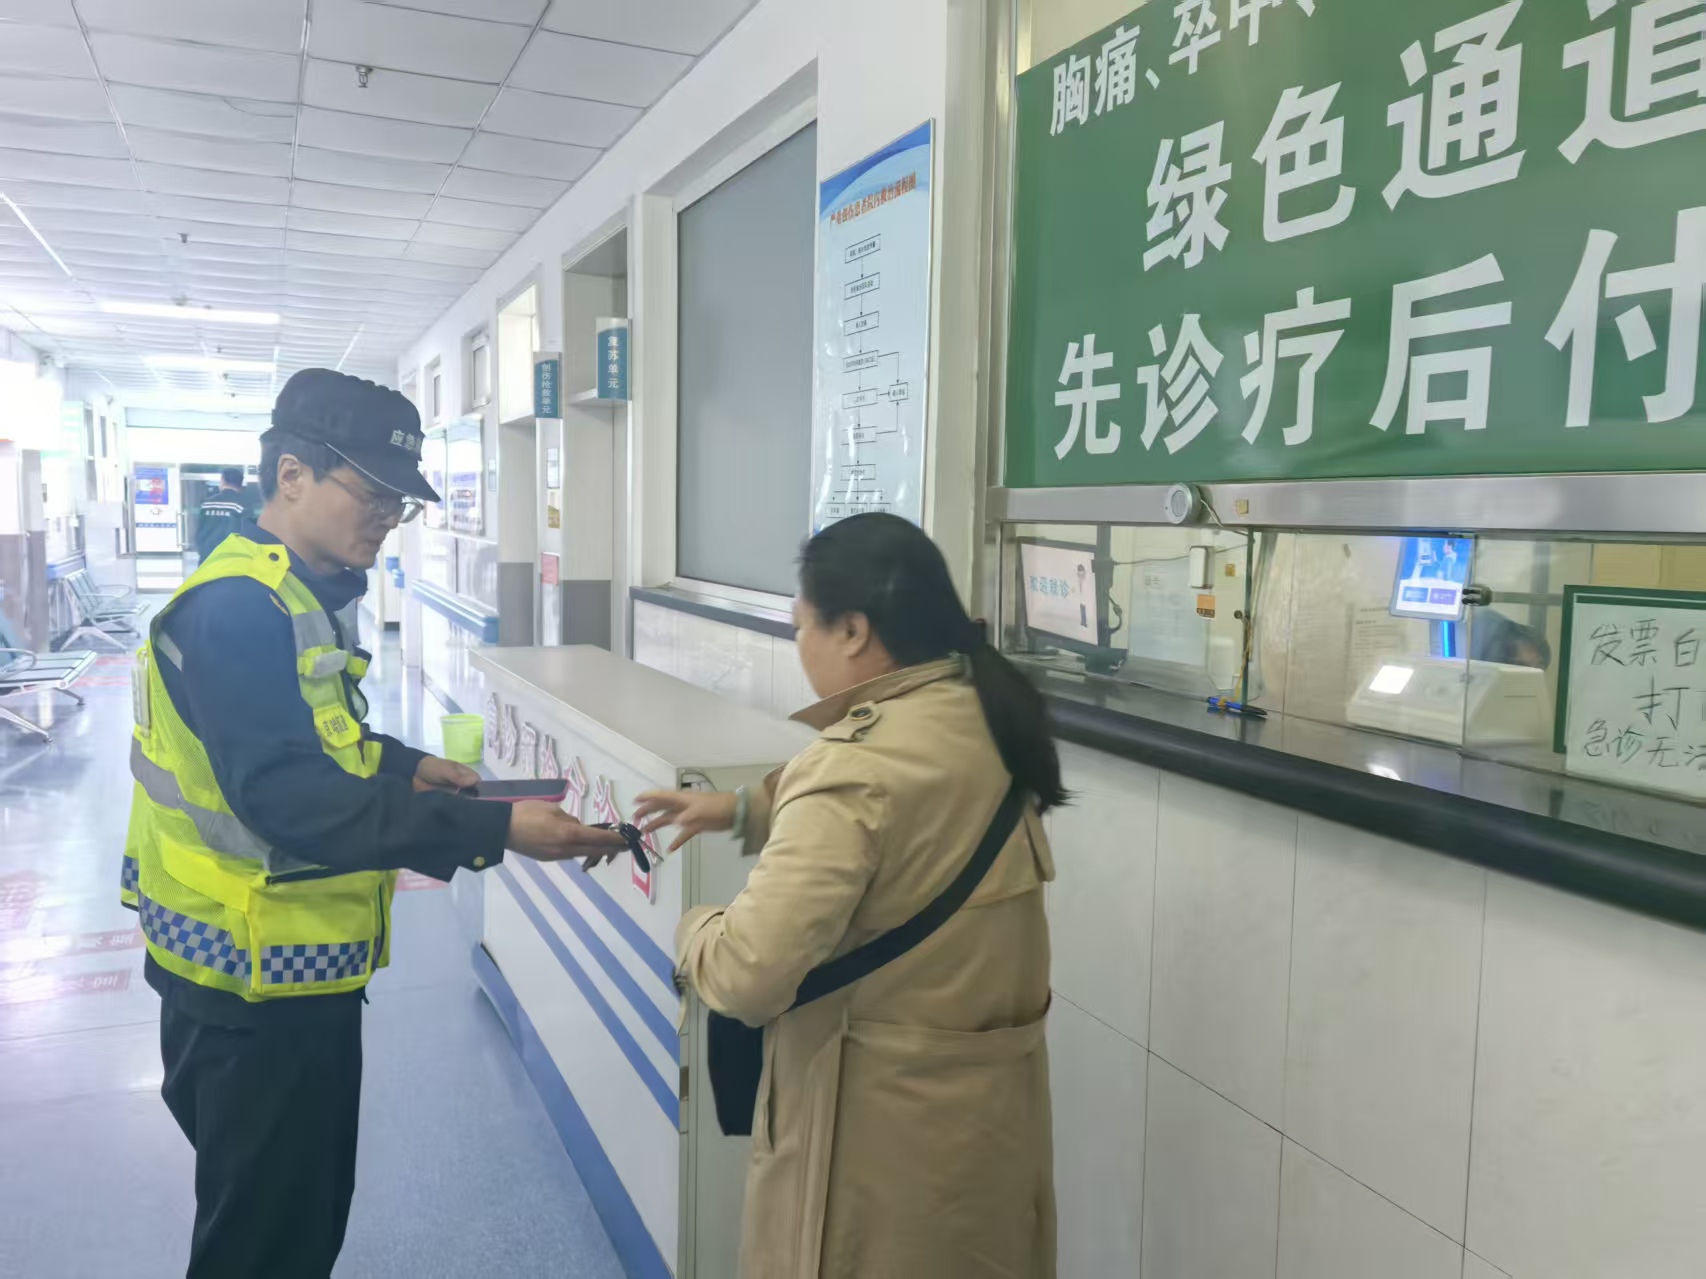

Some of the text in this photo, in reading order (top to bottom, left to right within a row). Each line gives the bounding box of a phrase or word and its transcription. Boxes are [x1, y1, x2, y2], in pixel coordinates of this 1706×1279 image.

[1142, 0, 1706, 273] 绿色通道
[1053, 206, 1706, 460] 先诊疗后付
[1632, 674, 1706, 731] 打
